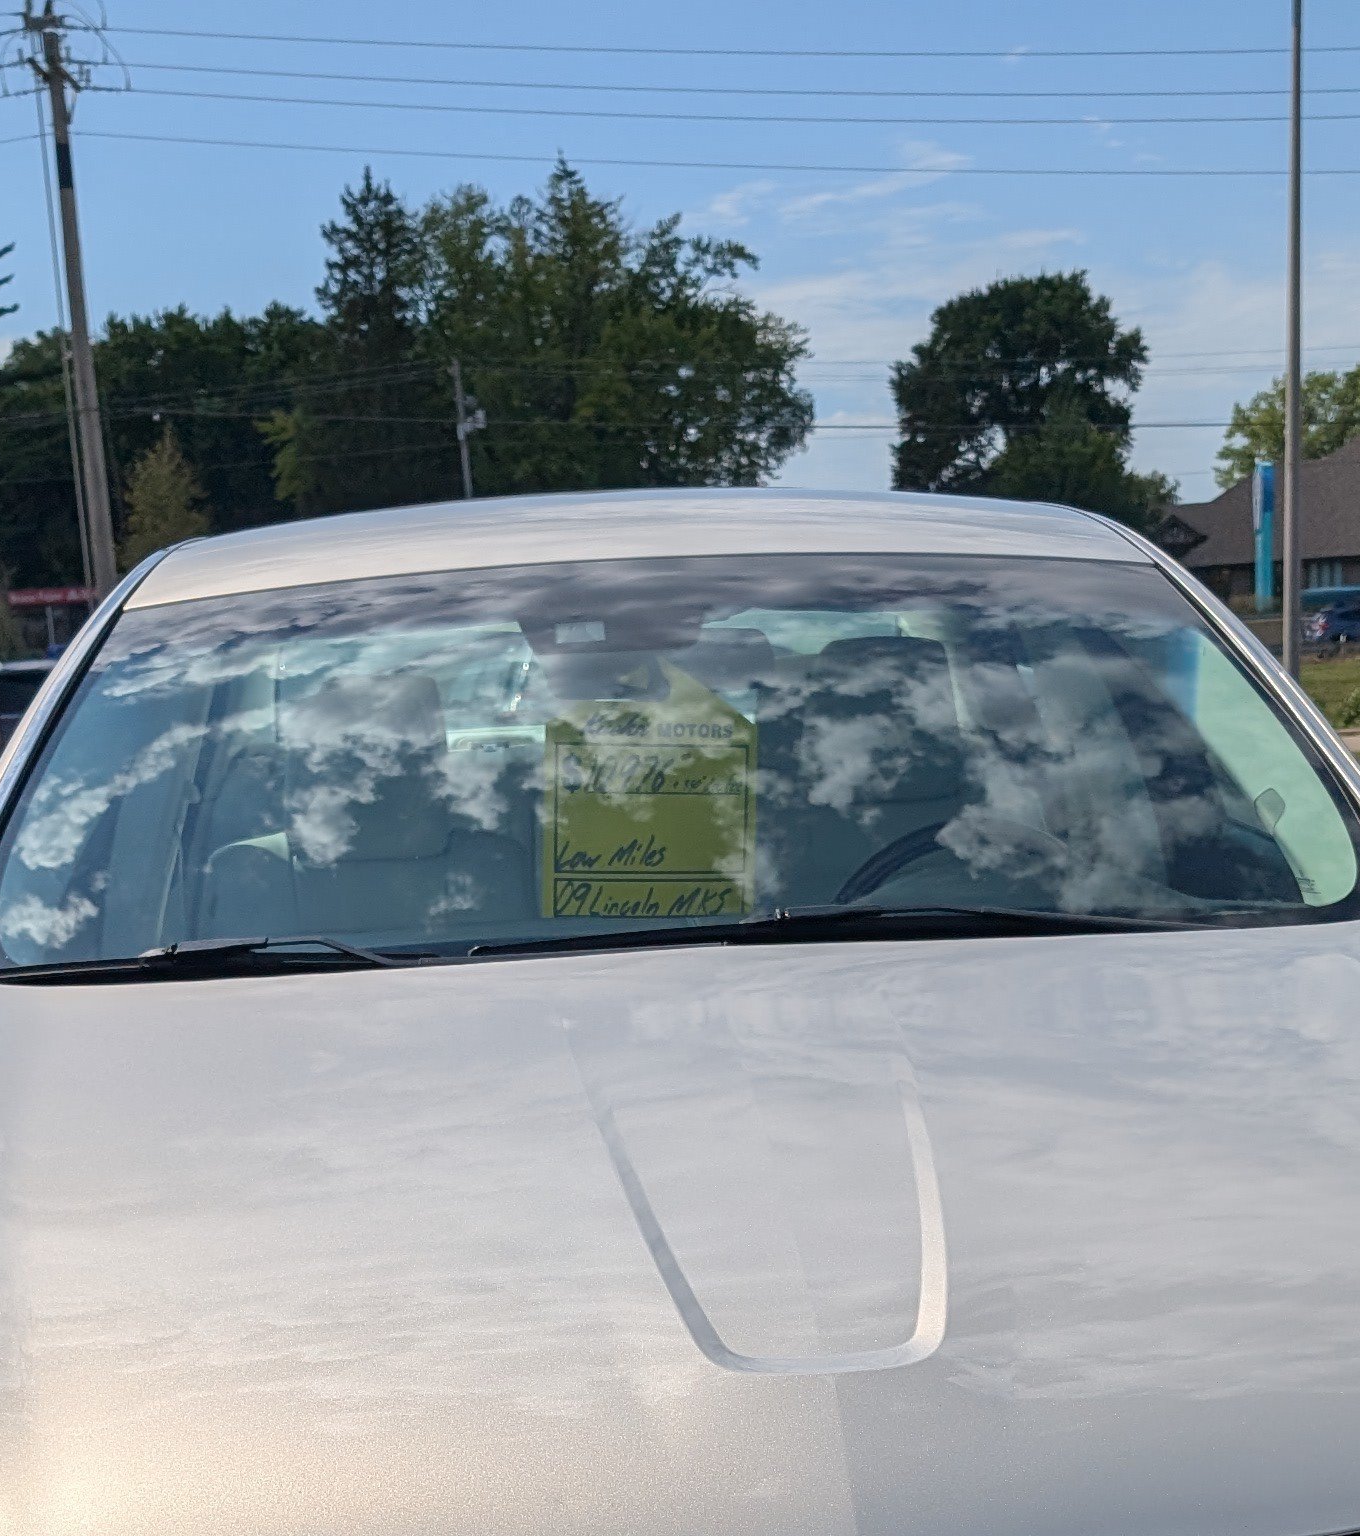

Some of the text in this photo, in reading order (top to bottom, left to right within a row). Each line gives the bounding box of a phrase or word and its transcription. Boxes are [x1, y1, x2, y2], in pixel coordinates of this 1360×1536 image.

[658, 722, 733, 739] MOTORS
[557, 835, 666, 871] Low Miles
[590, 886, 659, 916] Lincoln
[668, 887, 732, 916] MKS
